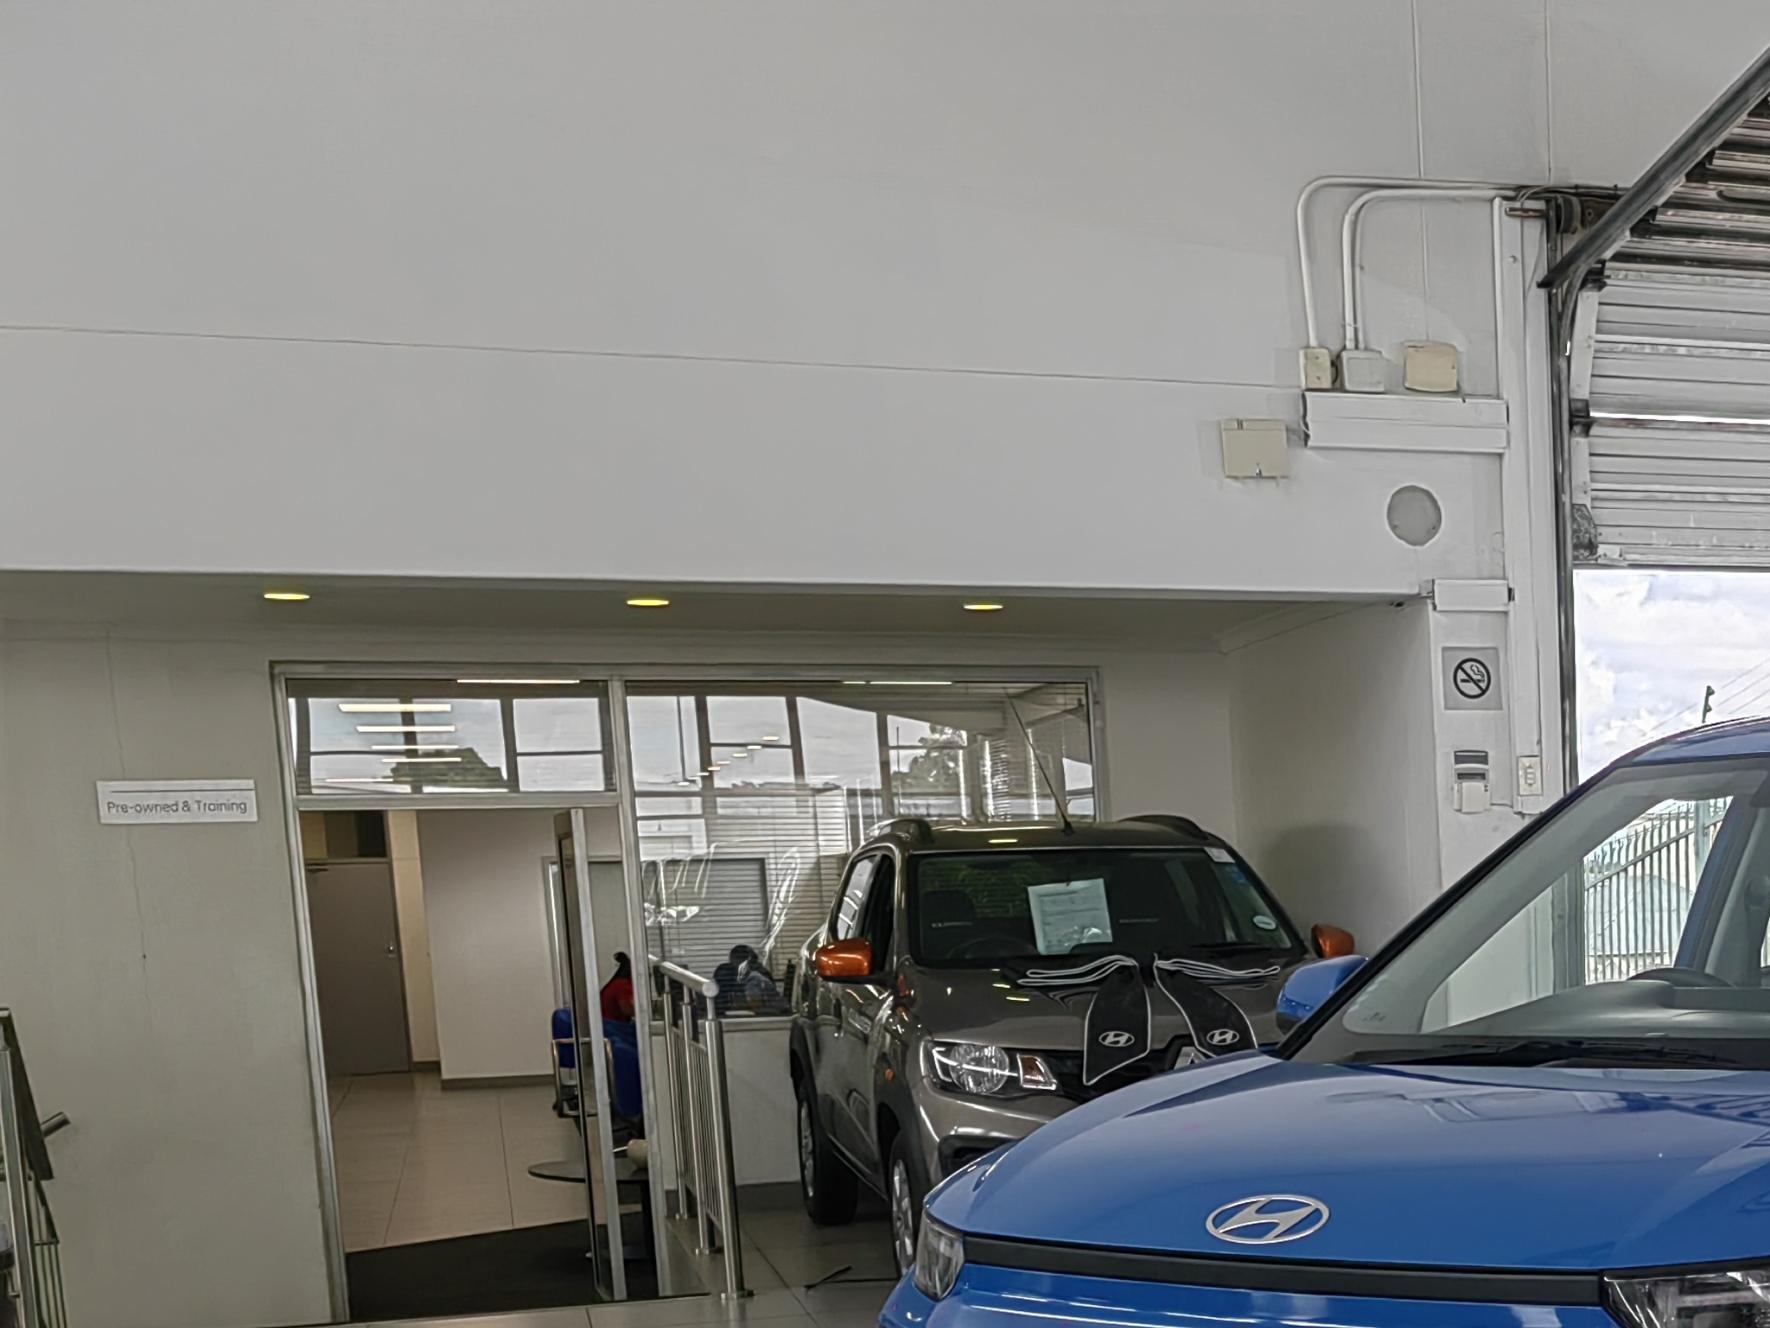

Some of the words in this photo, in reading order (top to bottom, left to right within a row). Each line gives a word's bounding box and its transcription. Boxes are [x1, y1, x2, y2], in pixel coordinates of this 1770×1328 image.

[106, 801, 179, 814] Pre-owned
[181, 800, 191, 812] &
[195, 799, 248, 814] Training
